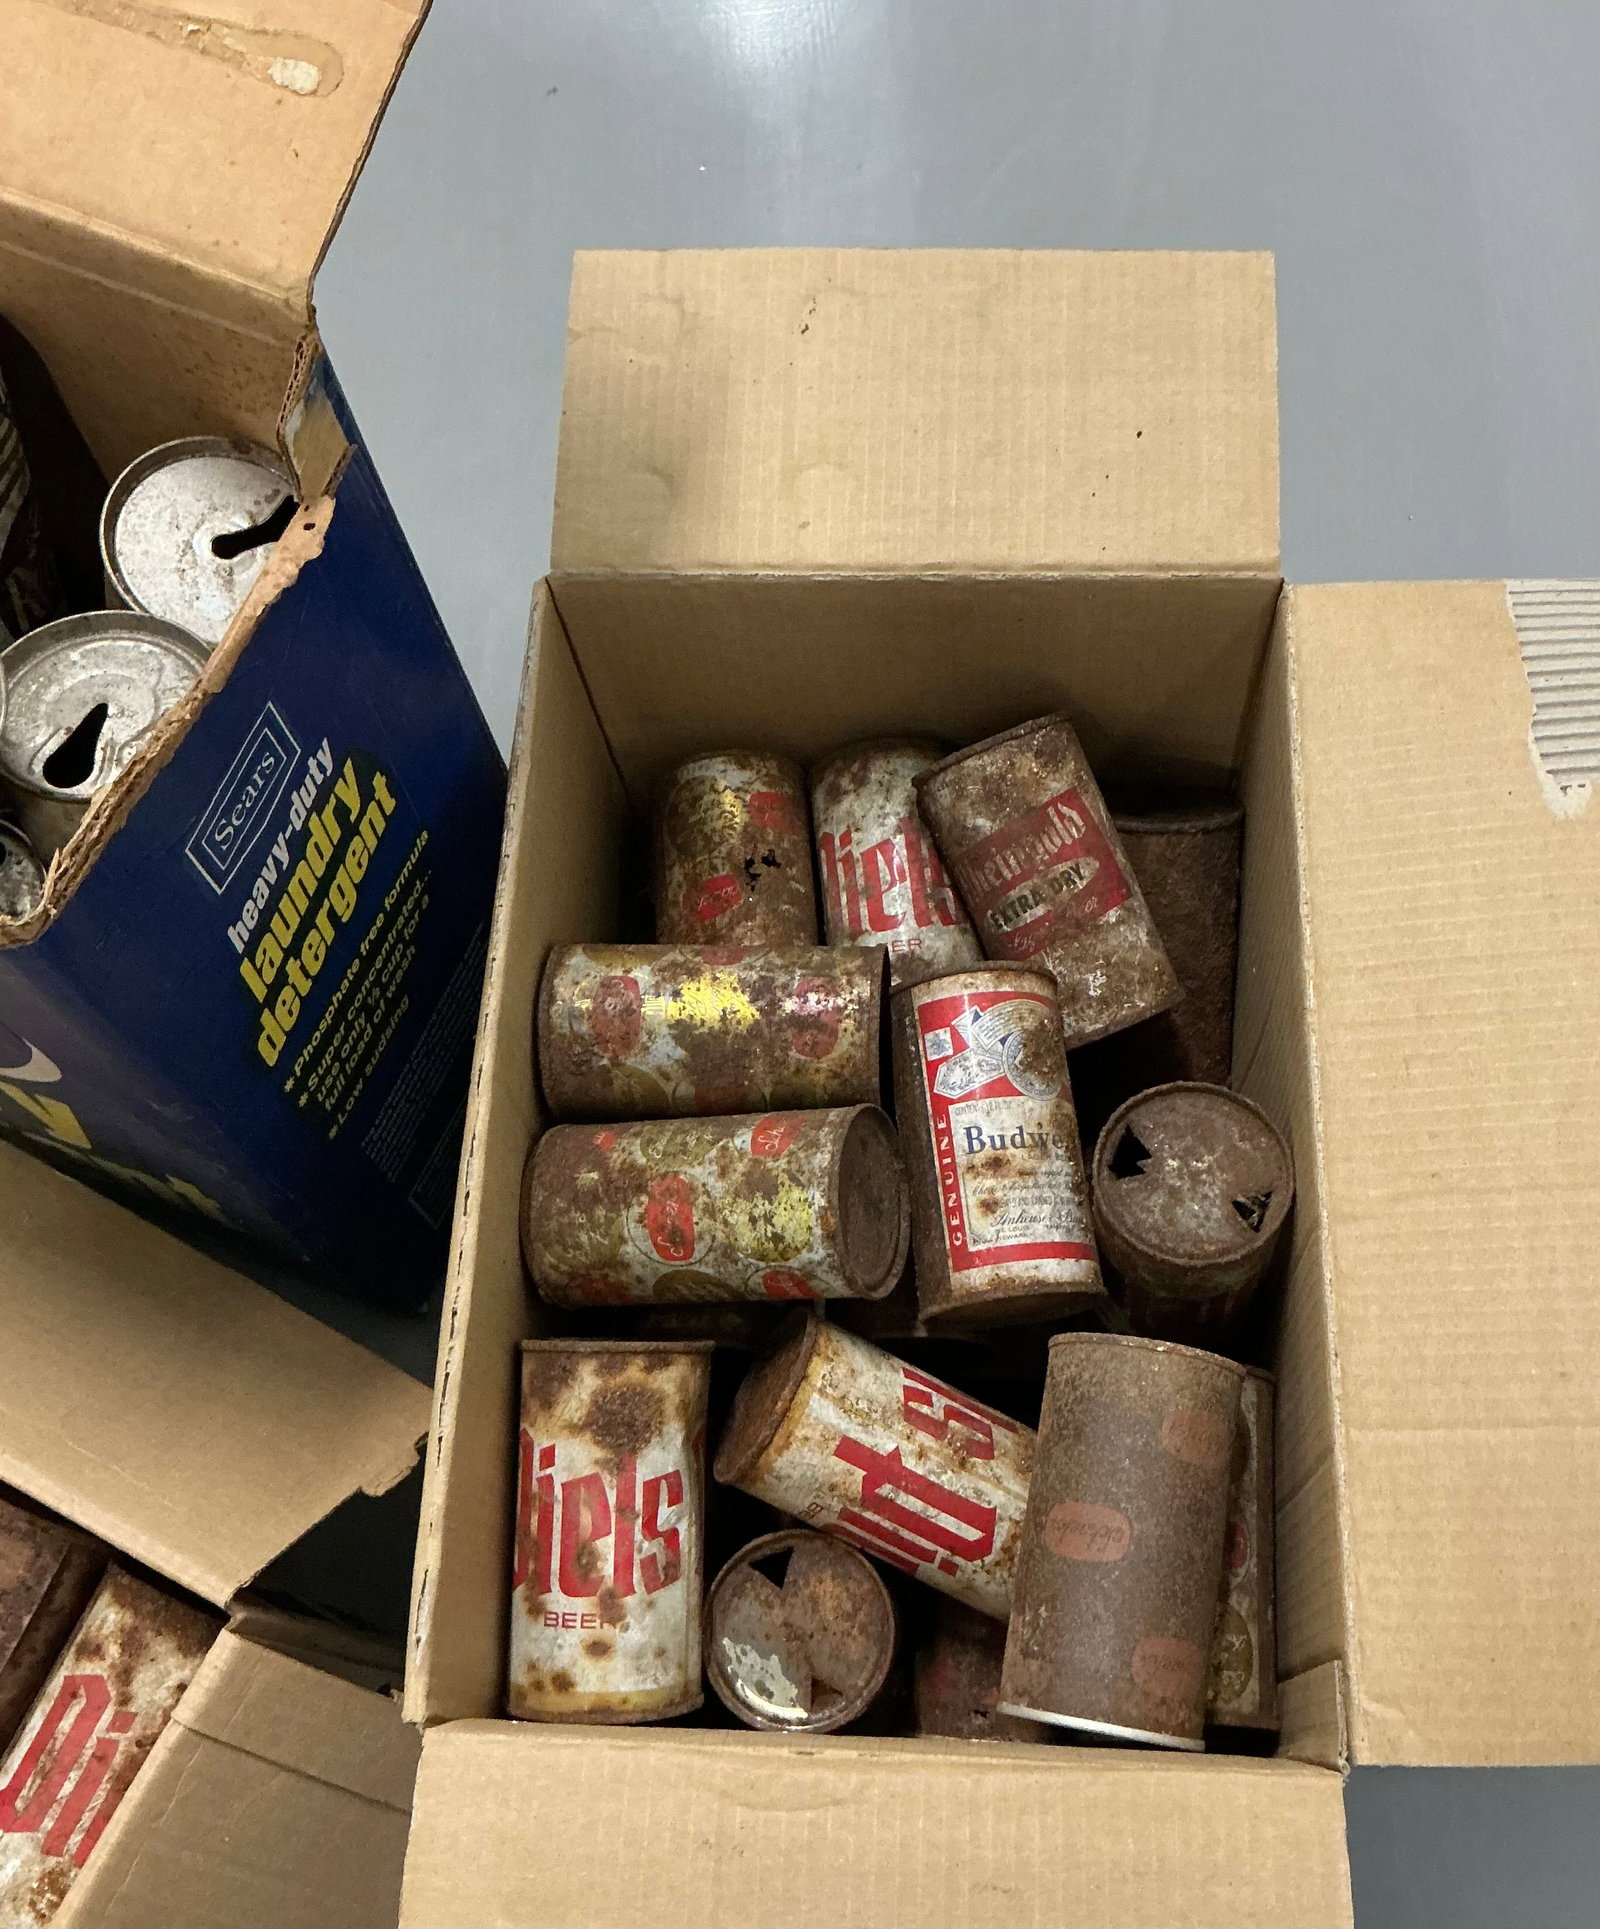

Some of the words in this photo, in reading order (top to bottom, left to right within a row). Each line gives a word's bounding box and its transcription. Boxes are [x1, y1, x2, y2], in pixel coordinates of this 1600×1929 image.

[214, 752, 275, 851] Sears
[227, 737, 334, 954] heavy-duty
[240, 757, 361, 1003] laundry
[257, 771, 397, 1067] detergent
[294, 957, 360, 1077] Phosphate
[360, 912, 385, 956] free
[384, 830, 429, 911] formula
[1048, 862, 1084, 895] DRY
[308, 1021, 346, 1092] Super
[317, 1061, 340, 1102] use
[341, 1011, 366, 1059] only
[381, 943, 404, 983] cup
[404, 909, 420, 940] for
[421, 894, 430, 910] a
[325, 1072, 346, 1112] full
[345, 1022, 373, 1075] load
[373, 999, 386, 1024] of
[386, 944, 416, 999] wash
[337, 1076, 363, 1125] Low
[364, 993, 410, 1077] sudsing
[936, 1113, 964, 1247] GENUINE
[963, 1125, 1068, 1155] Budwe
